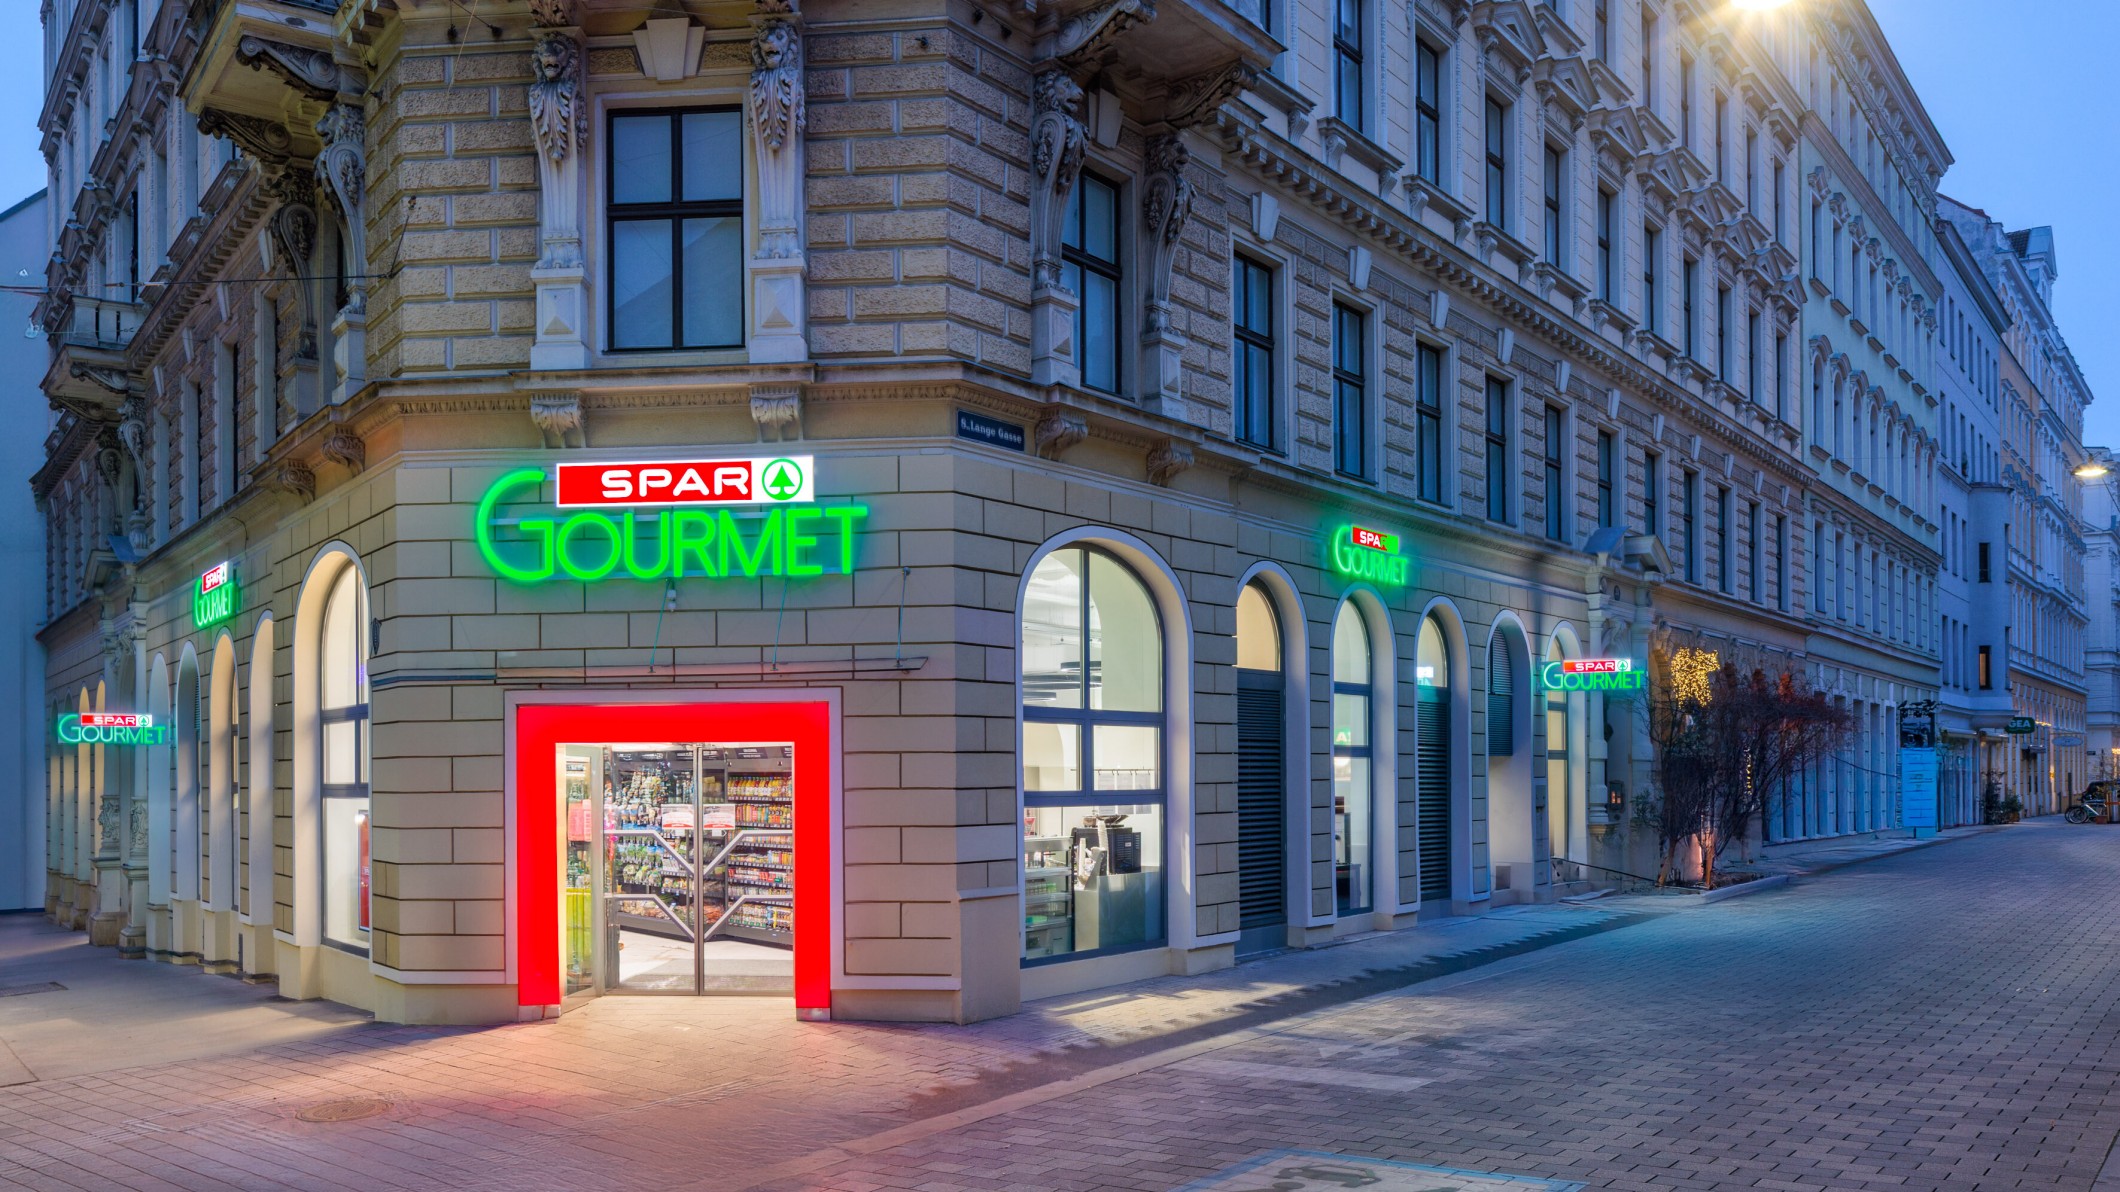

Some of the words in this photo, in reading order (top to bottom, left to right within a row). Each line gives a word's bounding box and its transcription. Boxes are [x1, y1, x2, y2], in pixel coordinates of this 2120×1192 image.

[970, 419, 996, 438] Lange
[998, 427, 1022, 444] Gasse
[601, 467, 750, 498] SPAR
[476, 469, 868, 581] GOURMET
[1359, 530, 1388, 551] SPAR
[205, 567, 222, 589] SPAR
[1543, 661, 1645, 691] GOURMET
[1575, 661, 1615, 671] SPAR
[57, 713, 166, 745] GOURMET
[92, 715, 136, 726] SPAR
[2008, 719, 2031, 728] GEA
